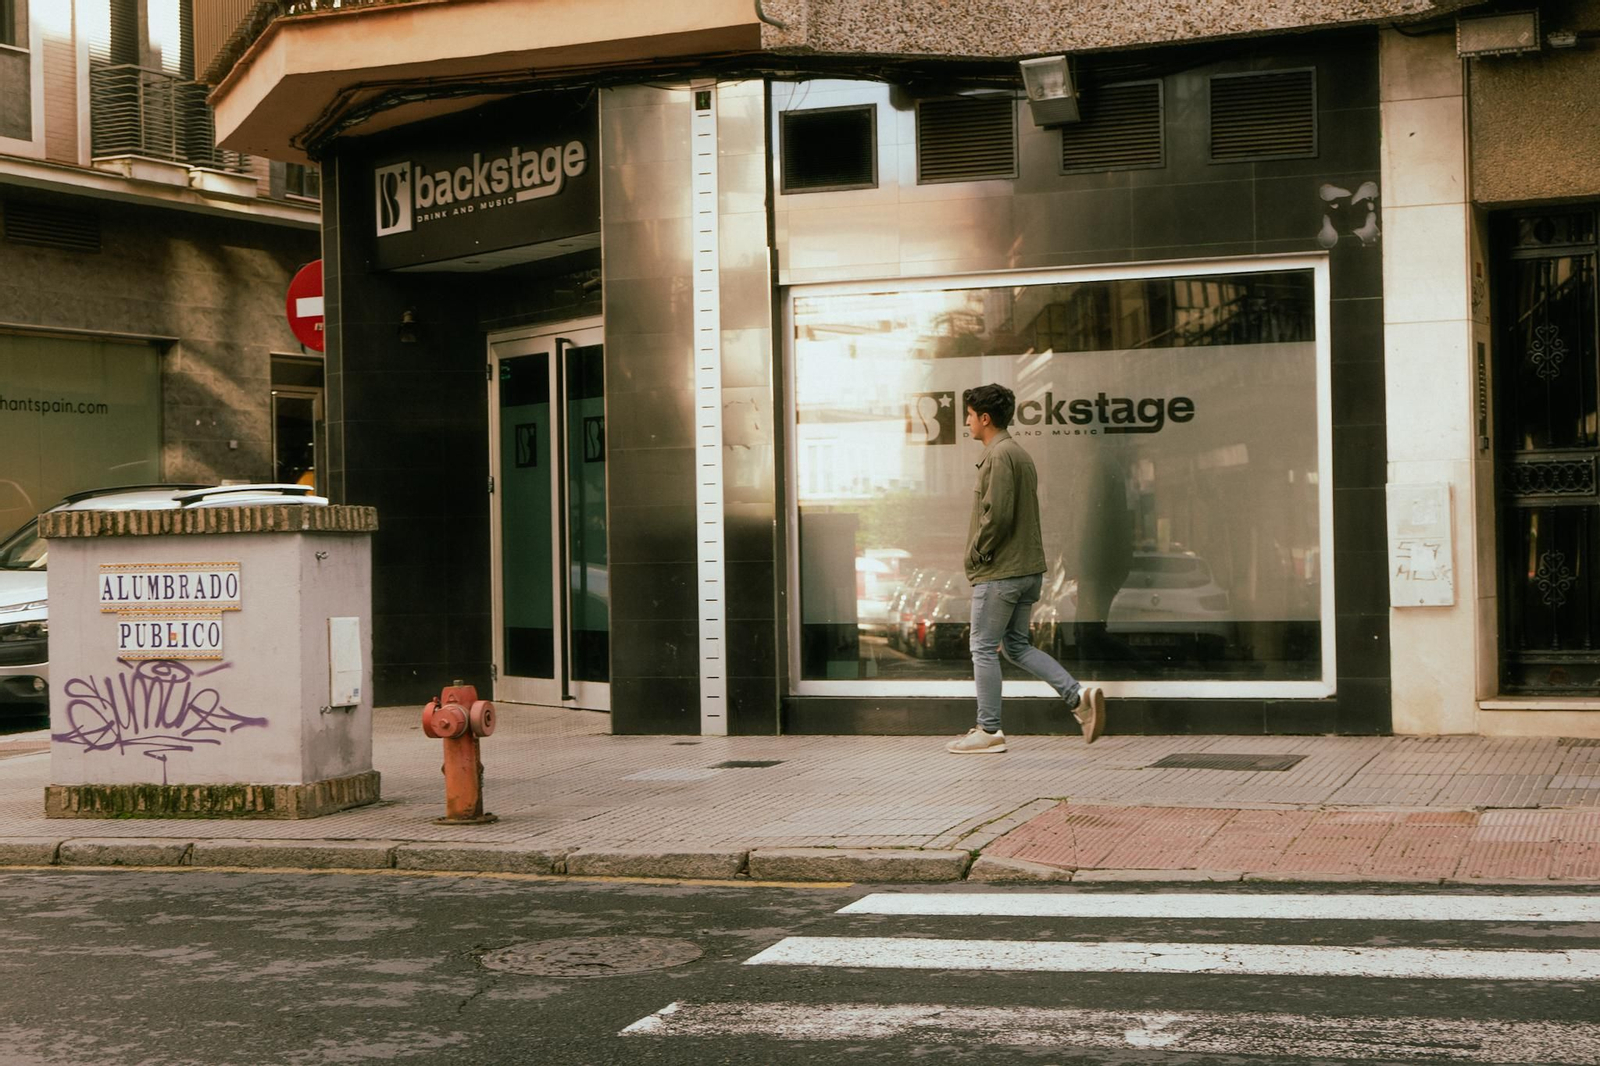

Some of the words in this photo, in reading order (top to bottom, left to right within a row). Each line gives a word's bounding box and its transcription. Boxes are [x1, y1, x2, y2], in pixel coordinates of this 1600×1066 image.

[415, 141, 586, 209] backstage
[417, 211, 447, 223] DRINK
[453, 205, 474, 216] AND
[480, 197, 514, 210] MUSIC
[102, 573, 237, 600] ALUMBRADO
[120, 622, 220, 648] PUBLICO
